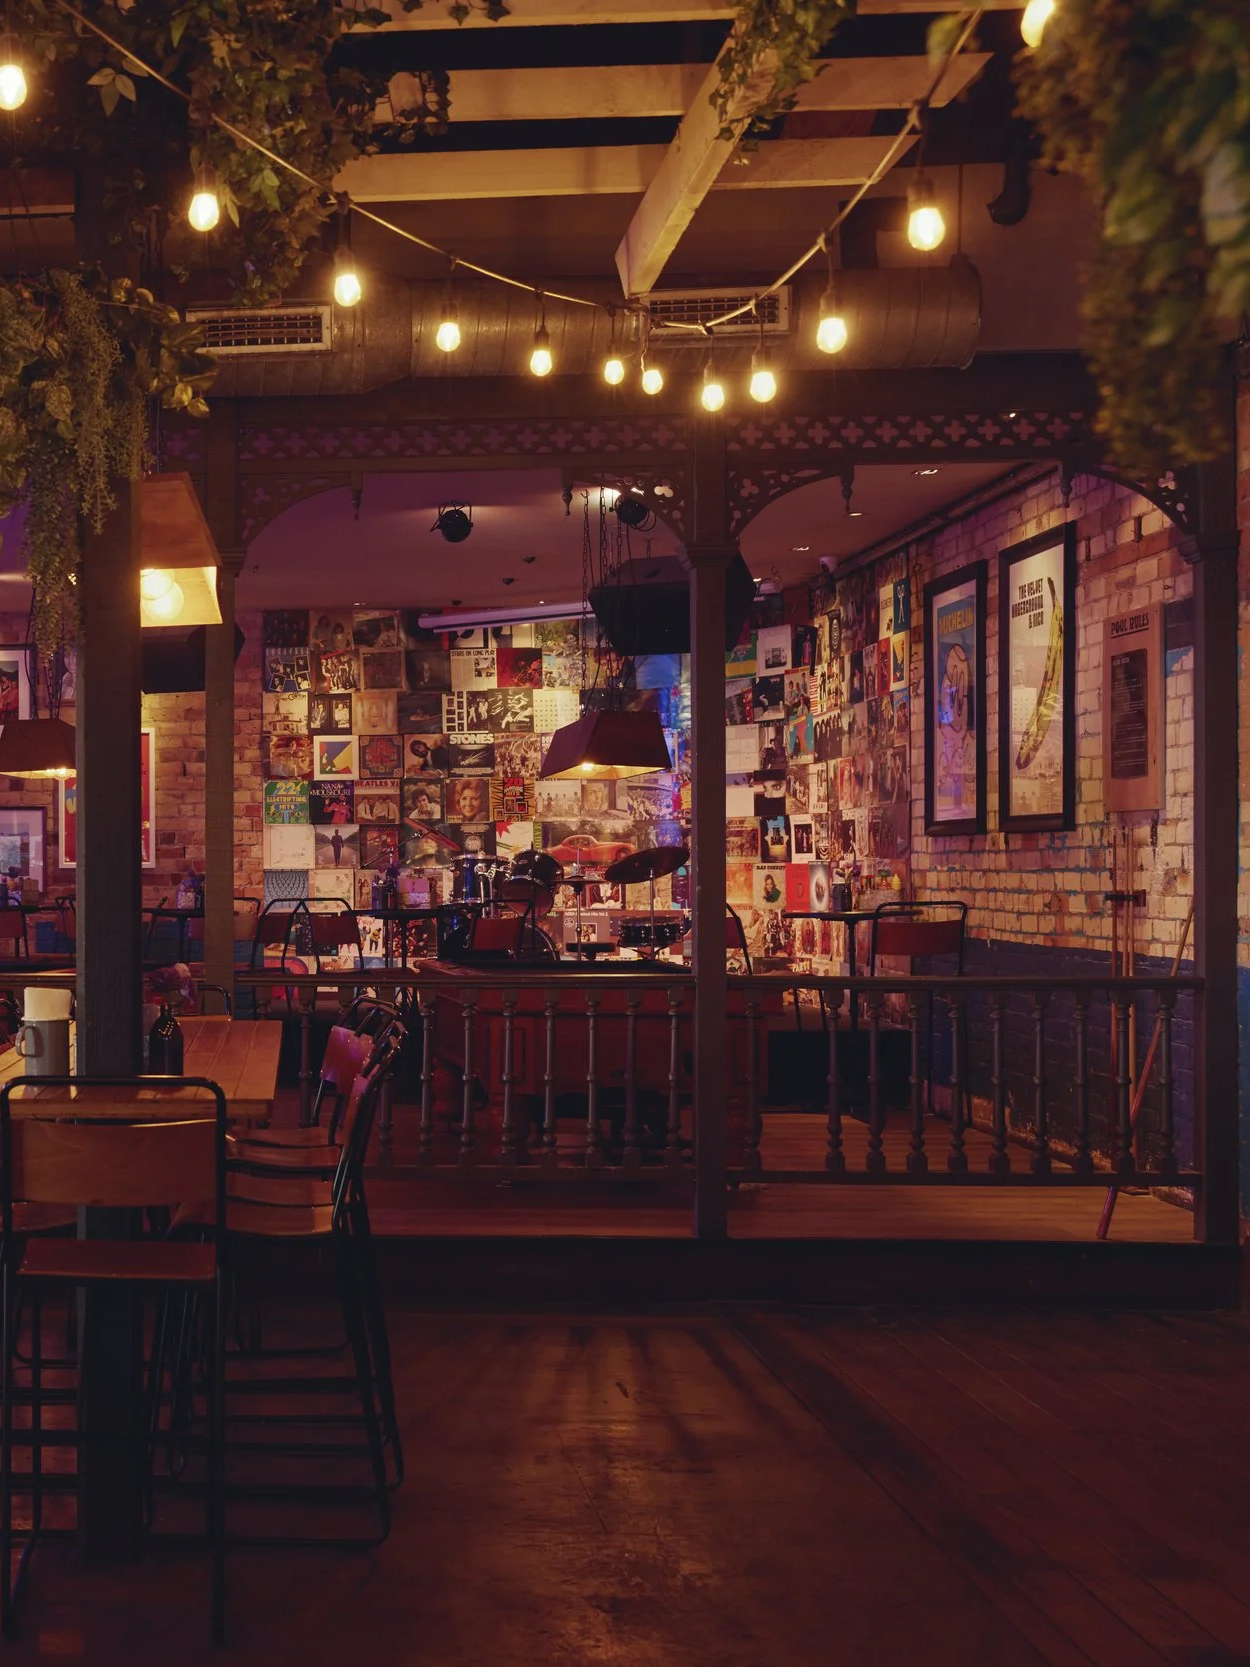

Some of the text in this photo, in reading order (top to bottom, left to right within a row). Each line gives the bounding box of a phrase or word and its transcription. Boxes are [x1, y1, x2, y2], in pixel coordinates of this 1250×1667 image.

[1027, 578, 1044, 598] VELVET
[1011, 595, 1044, 619] UNDERGROUND
[940, 608, 973, 635] MICHELIN
[1111, 613, 1149, 635] POOL RULES
[450, 733, 494, 745] STONES
